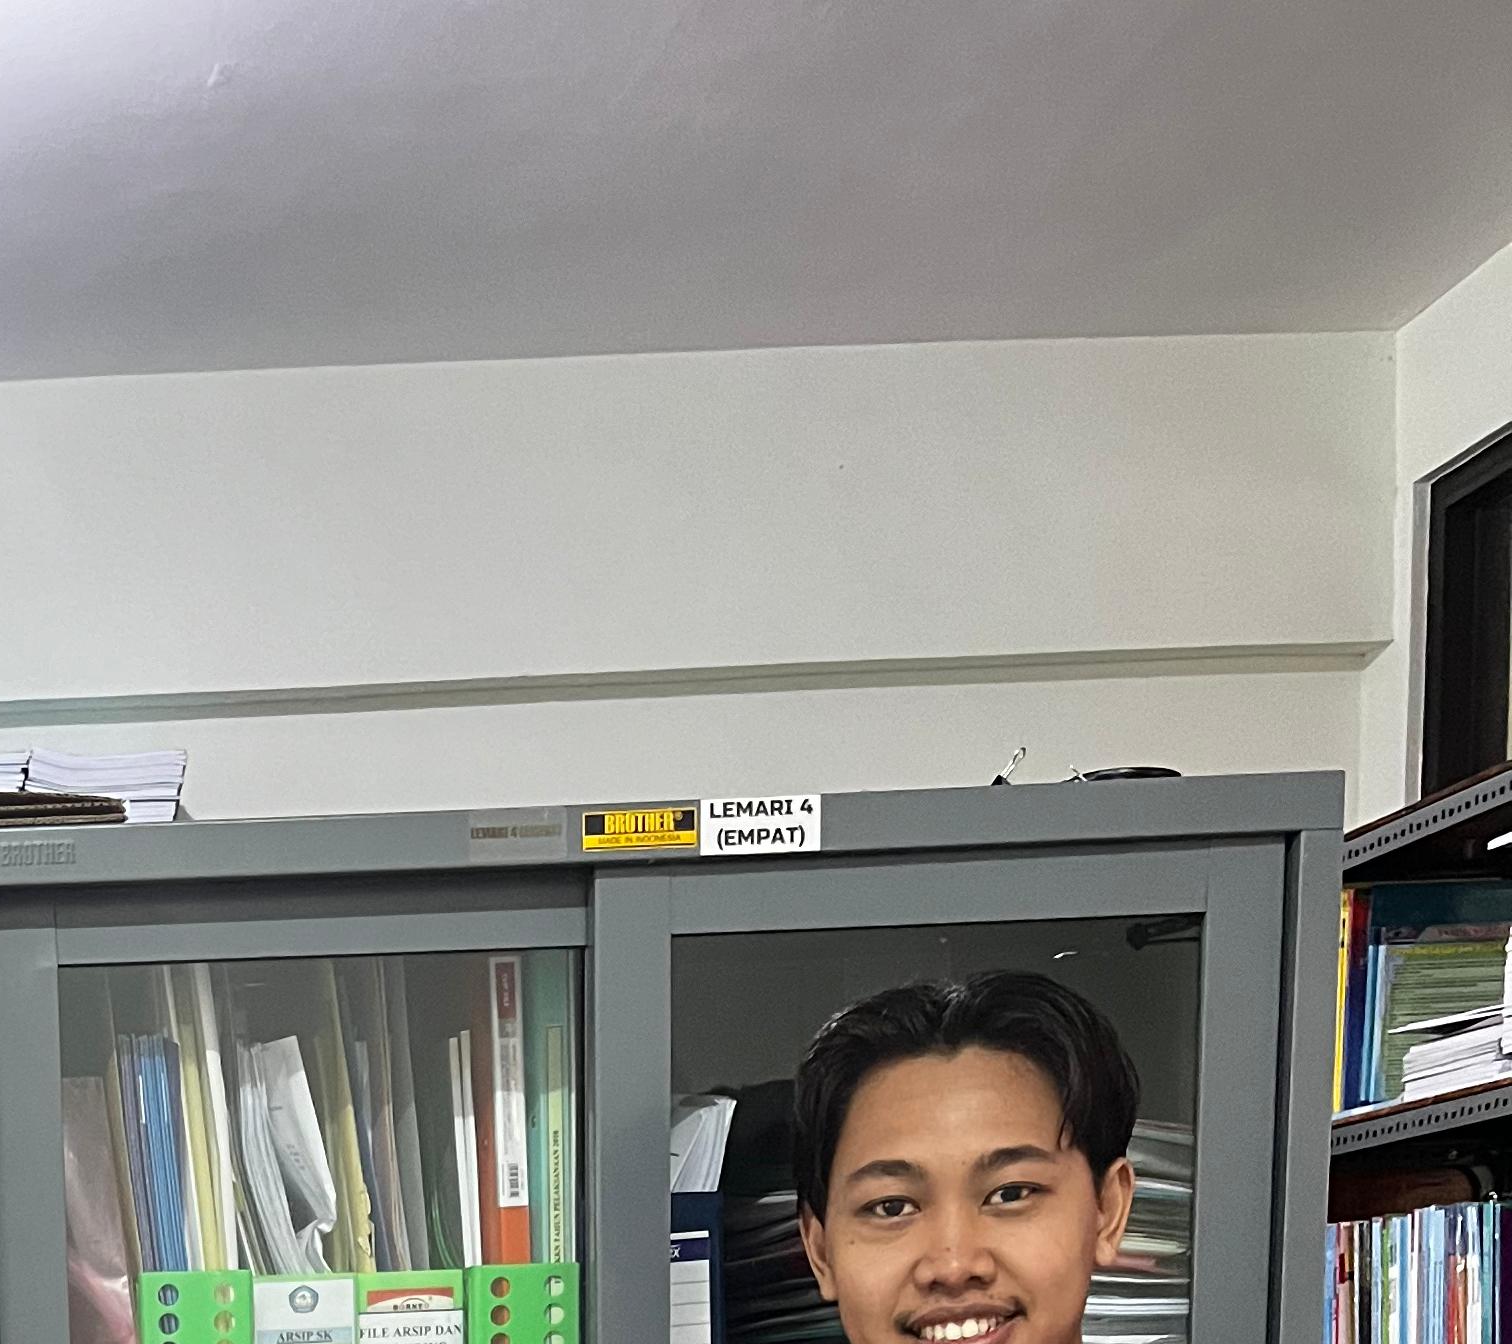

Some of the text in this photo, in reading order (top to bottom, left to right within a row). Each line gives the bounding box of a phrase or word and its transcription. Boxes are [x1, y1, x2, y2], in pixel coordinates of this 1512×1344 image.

[710, 799, 813, 819] LEMARI 4
[604, 811, 675, 834] BROTHER
[717, 826, 806, 850] (EMPAT)
[278, 1329, 333, 1343] ARSIP SK
[360, 1324, 463, 1339] FILE ARSIP DAN
